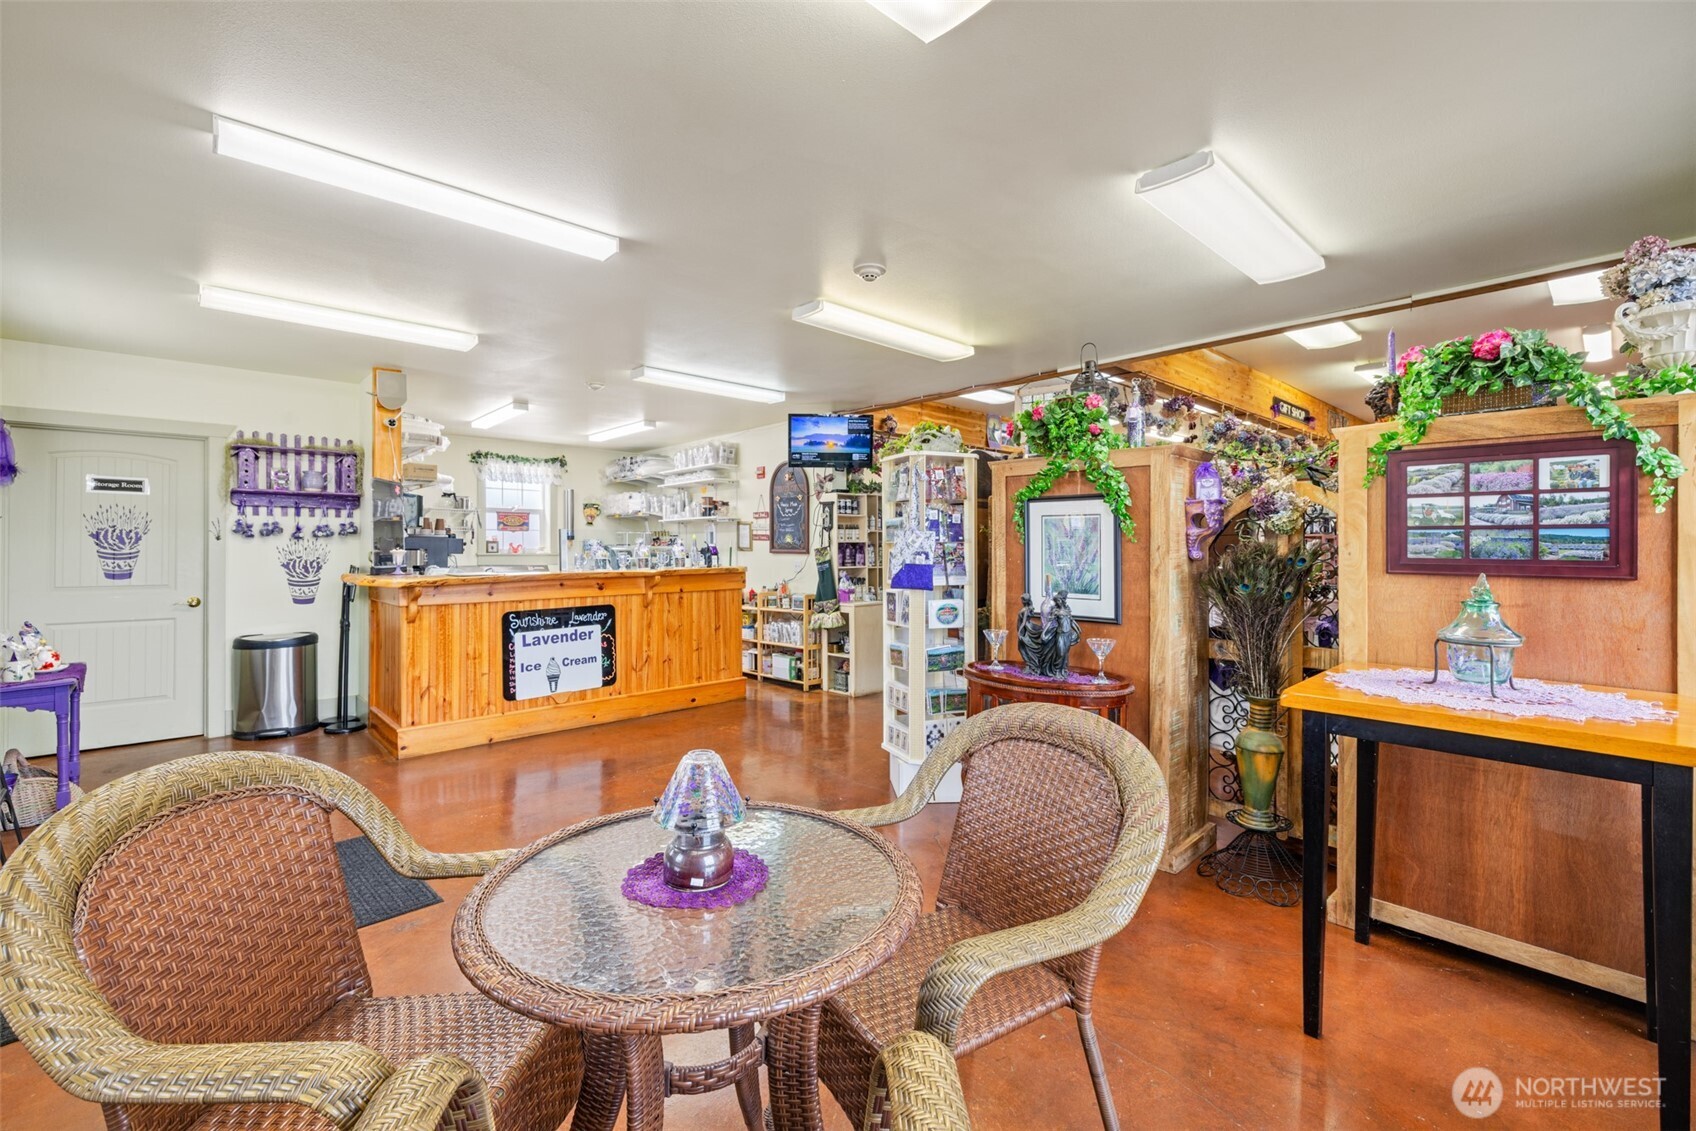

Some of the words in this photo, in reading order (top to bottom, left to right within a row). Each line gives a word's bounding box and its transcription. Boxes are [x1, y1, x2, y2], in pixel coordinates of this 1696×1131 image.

[1280, 401, 1292, 415] GIFT
[1292, 406, 1306, 421] SHOP
[509, 613, 559, 629] Sunshine
[569, 611, 608, 625] Lavender
[522, 629, 594, 648] Lavender
[520, 663, 542, 673] Ice
[562, 656, 597, 667] Cream
